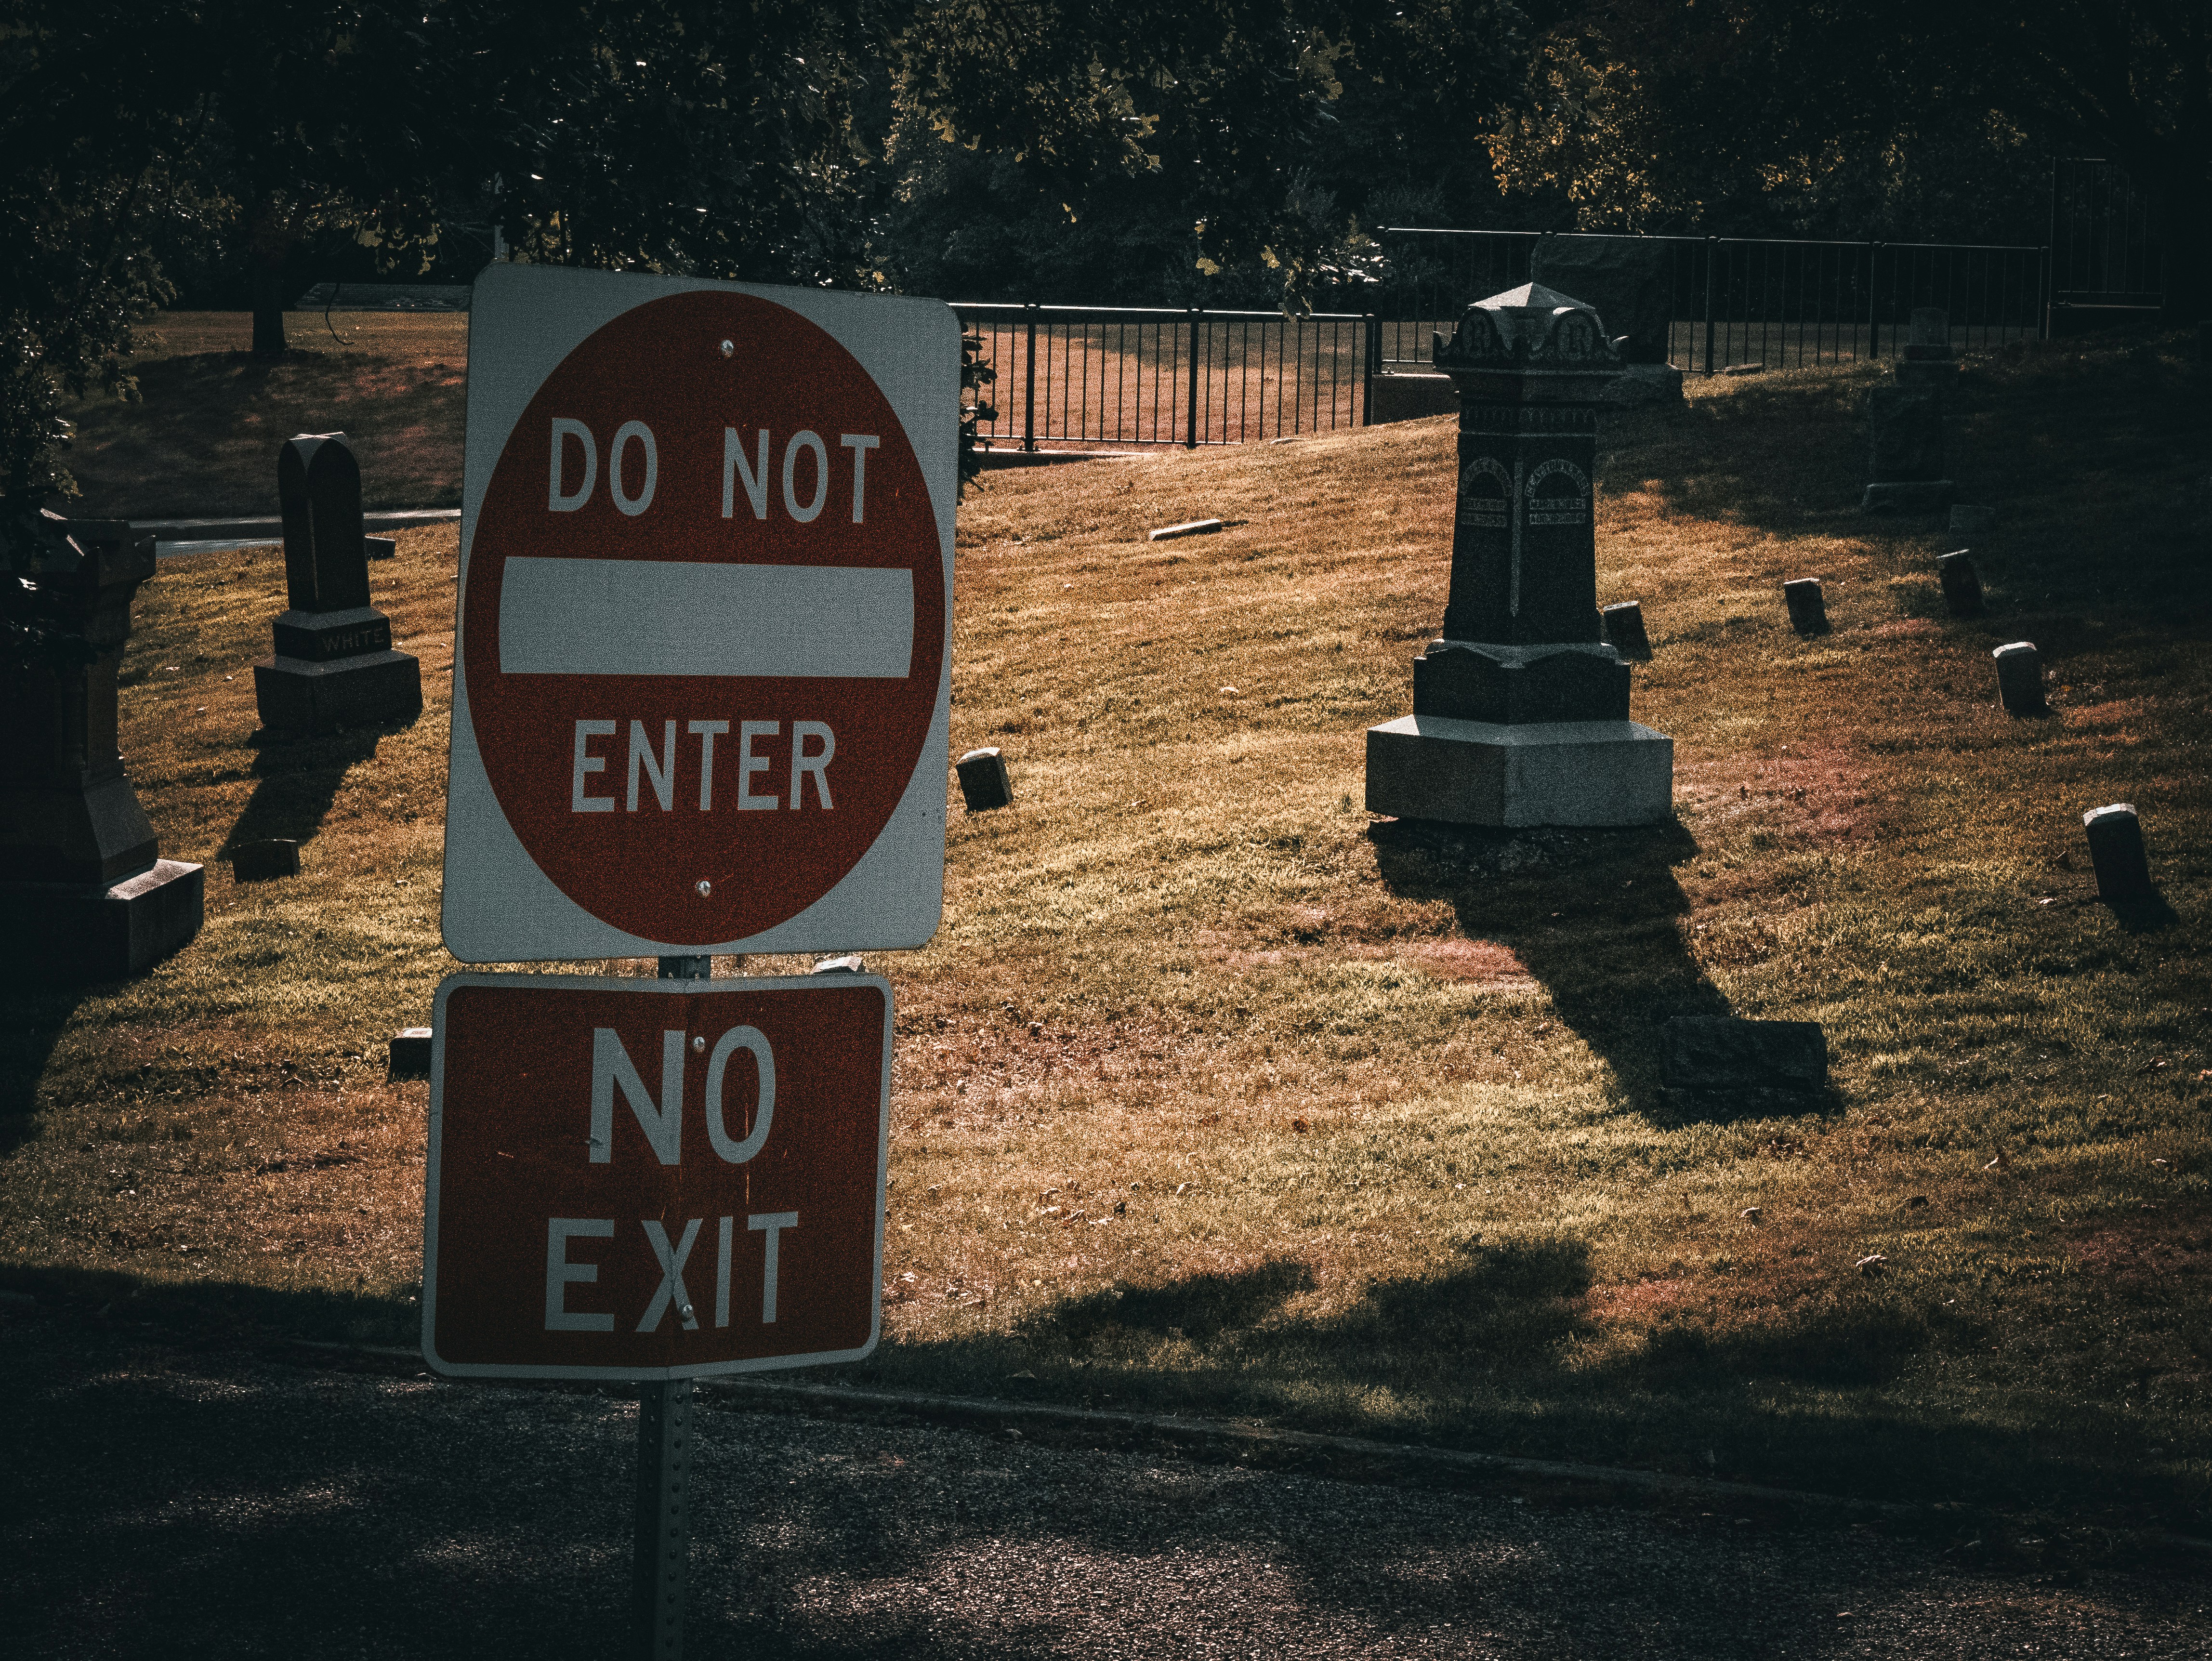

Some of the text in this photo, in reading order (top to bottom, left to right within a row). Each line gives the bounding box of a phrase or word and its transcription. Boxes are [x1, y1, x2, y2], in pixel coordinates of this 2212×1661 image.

[549, 418, 880, 524] DO NOT
[321, 627, 384, 652] WHITE
[571, 719, 836, 812] ENTER
[589, 1025, 776, 1165] NO
[545, 1211, 799, 1332] EXIT
